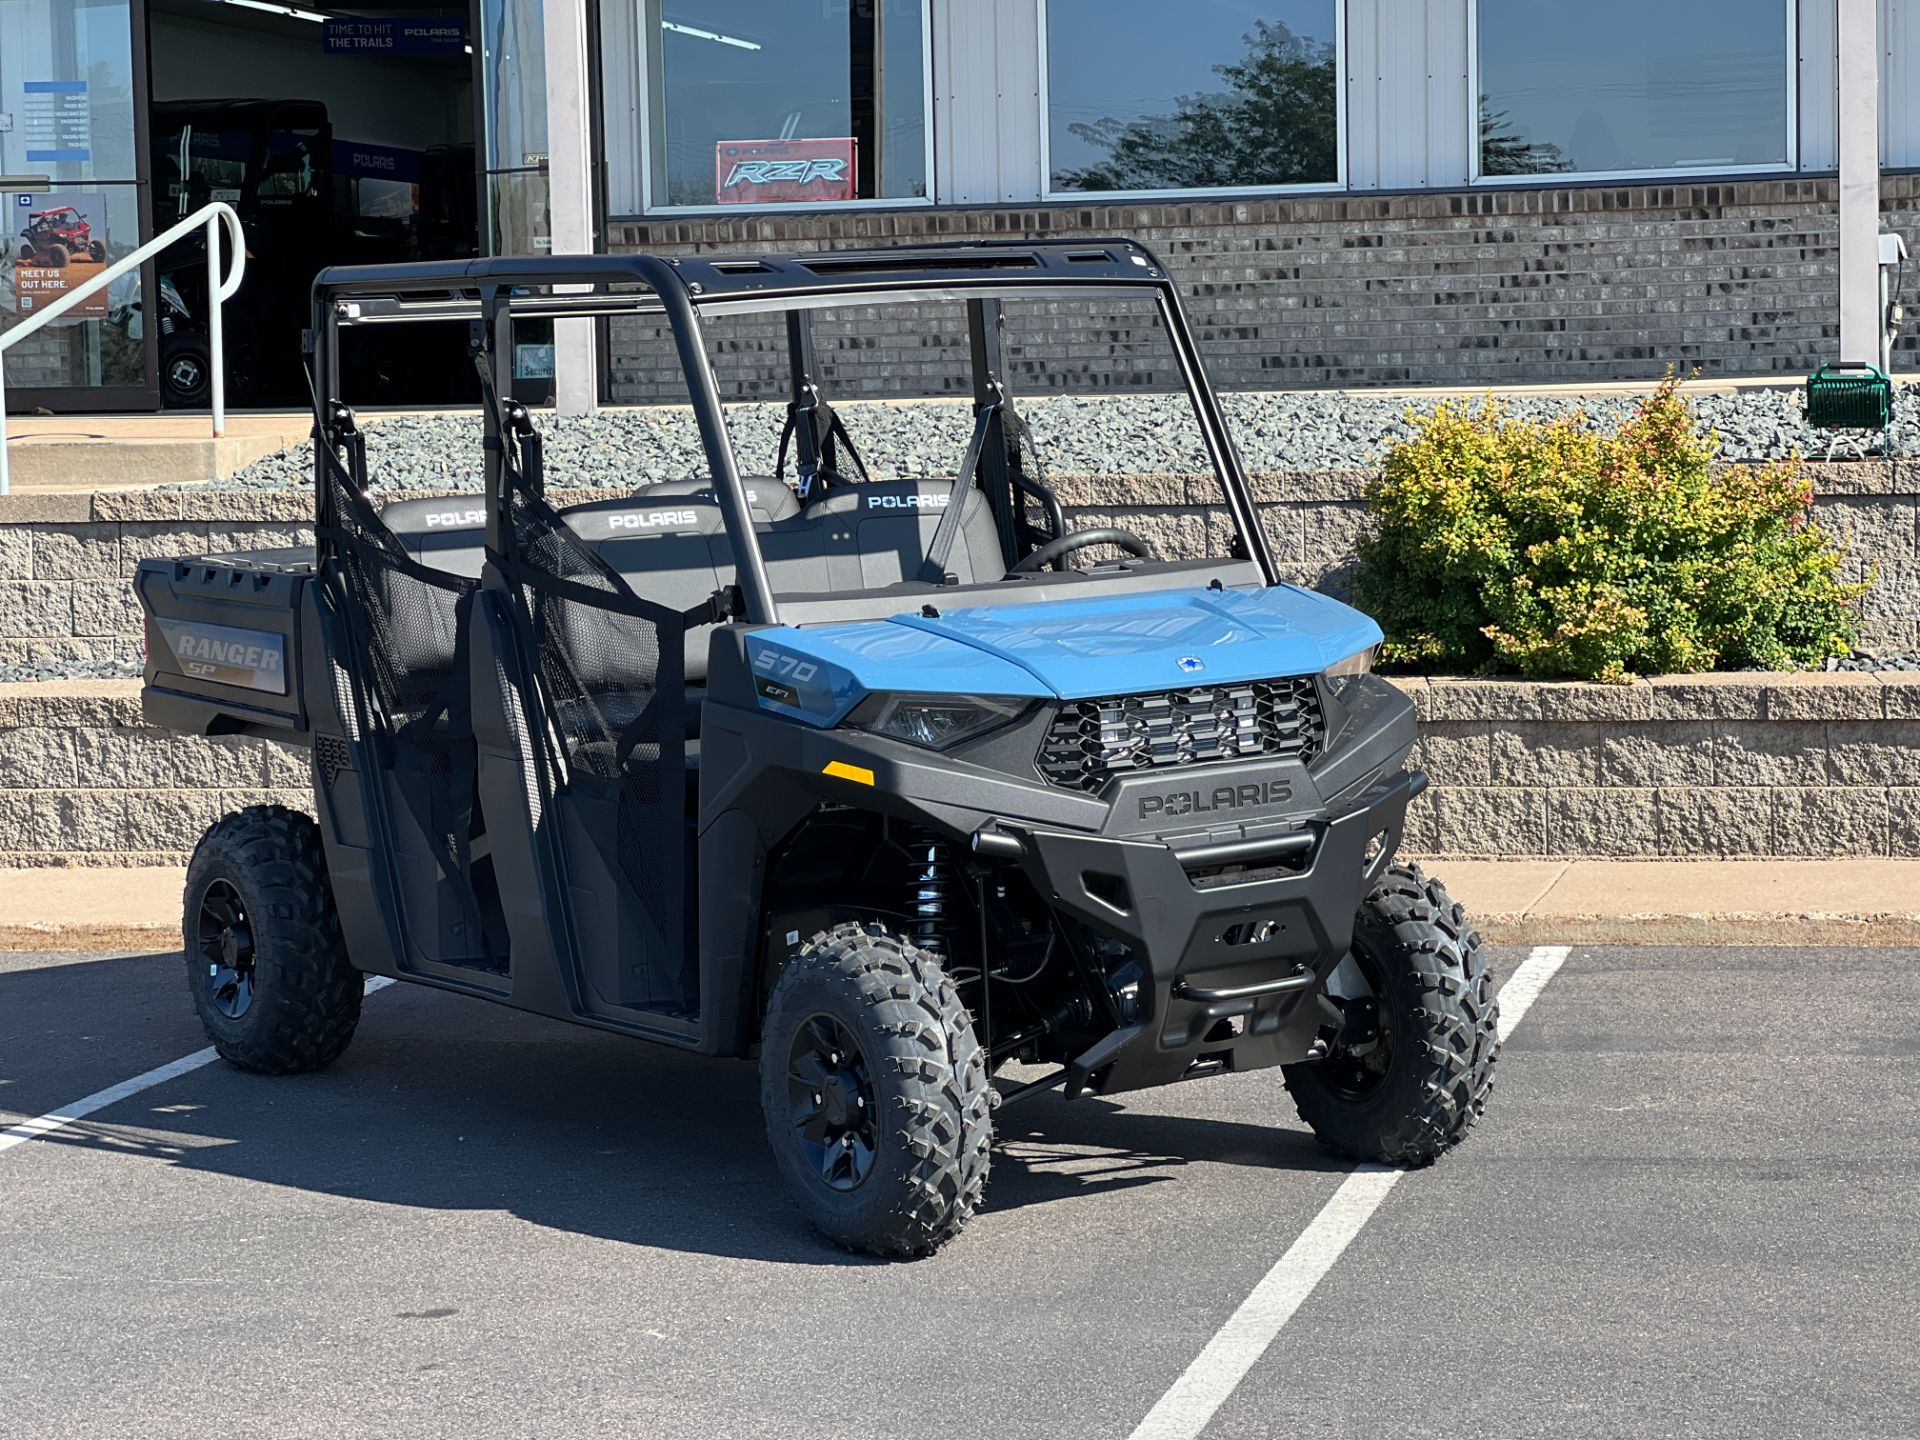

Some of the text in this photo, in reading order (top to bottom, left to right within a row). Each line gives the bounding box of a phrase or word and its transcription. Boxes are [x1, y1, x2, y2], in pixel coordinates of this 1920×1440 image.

[328, 24, 392, 35] TIME TO HIT
[404, 28, 460, 36] POLARIS
[328, 38, 393, 48] THE TRAILS
[353, 153, 395, 170] POLARIS
[724, 158, 848, 188] RZR
[20, 269, 60, 278] MEET US
[21, 280, 69, 289] OUT HERE.
[524, 365, 554, 377] Securit
[868, 494, 951, 509] POLARIS
[608, 510, 698, 529] POLARIS
[178, 635, 280, 671] RANGER
[188, 662, 216, 674] SP
[754, 649, 818, 682] 570
[765, 685, 789, 698] EFI
[1138, 779, 1293, 820] POLARIS
